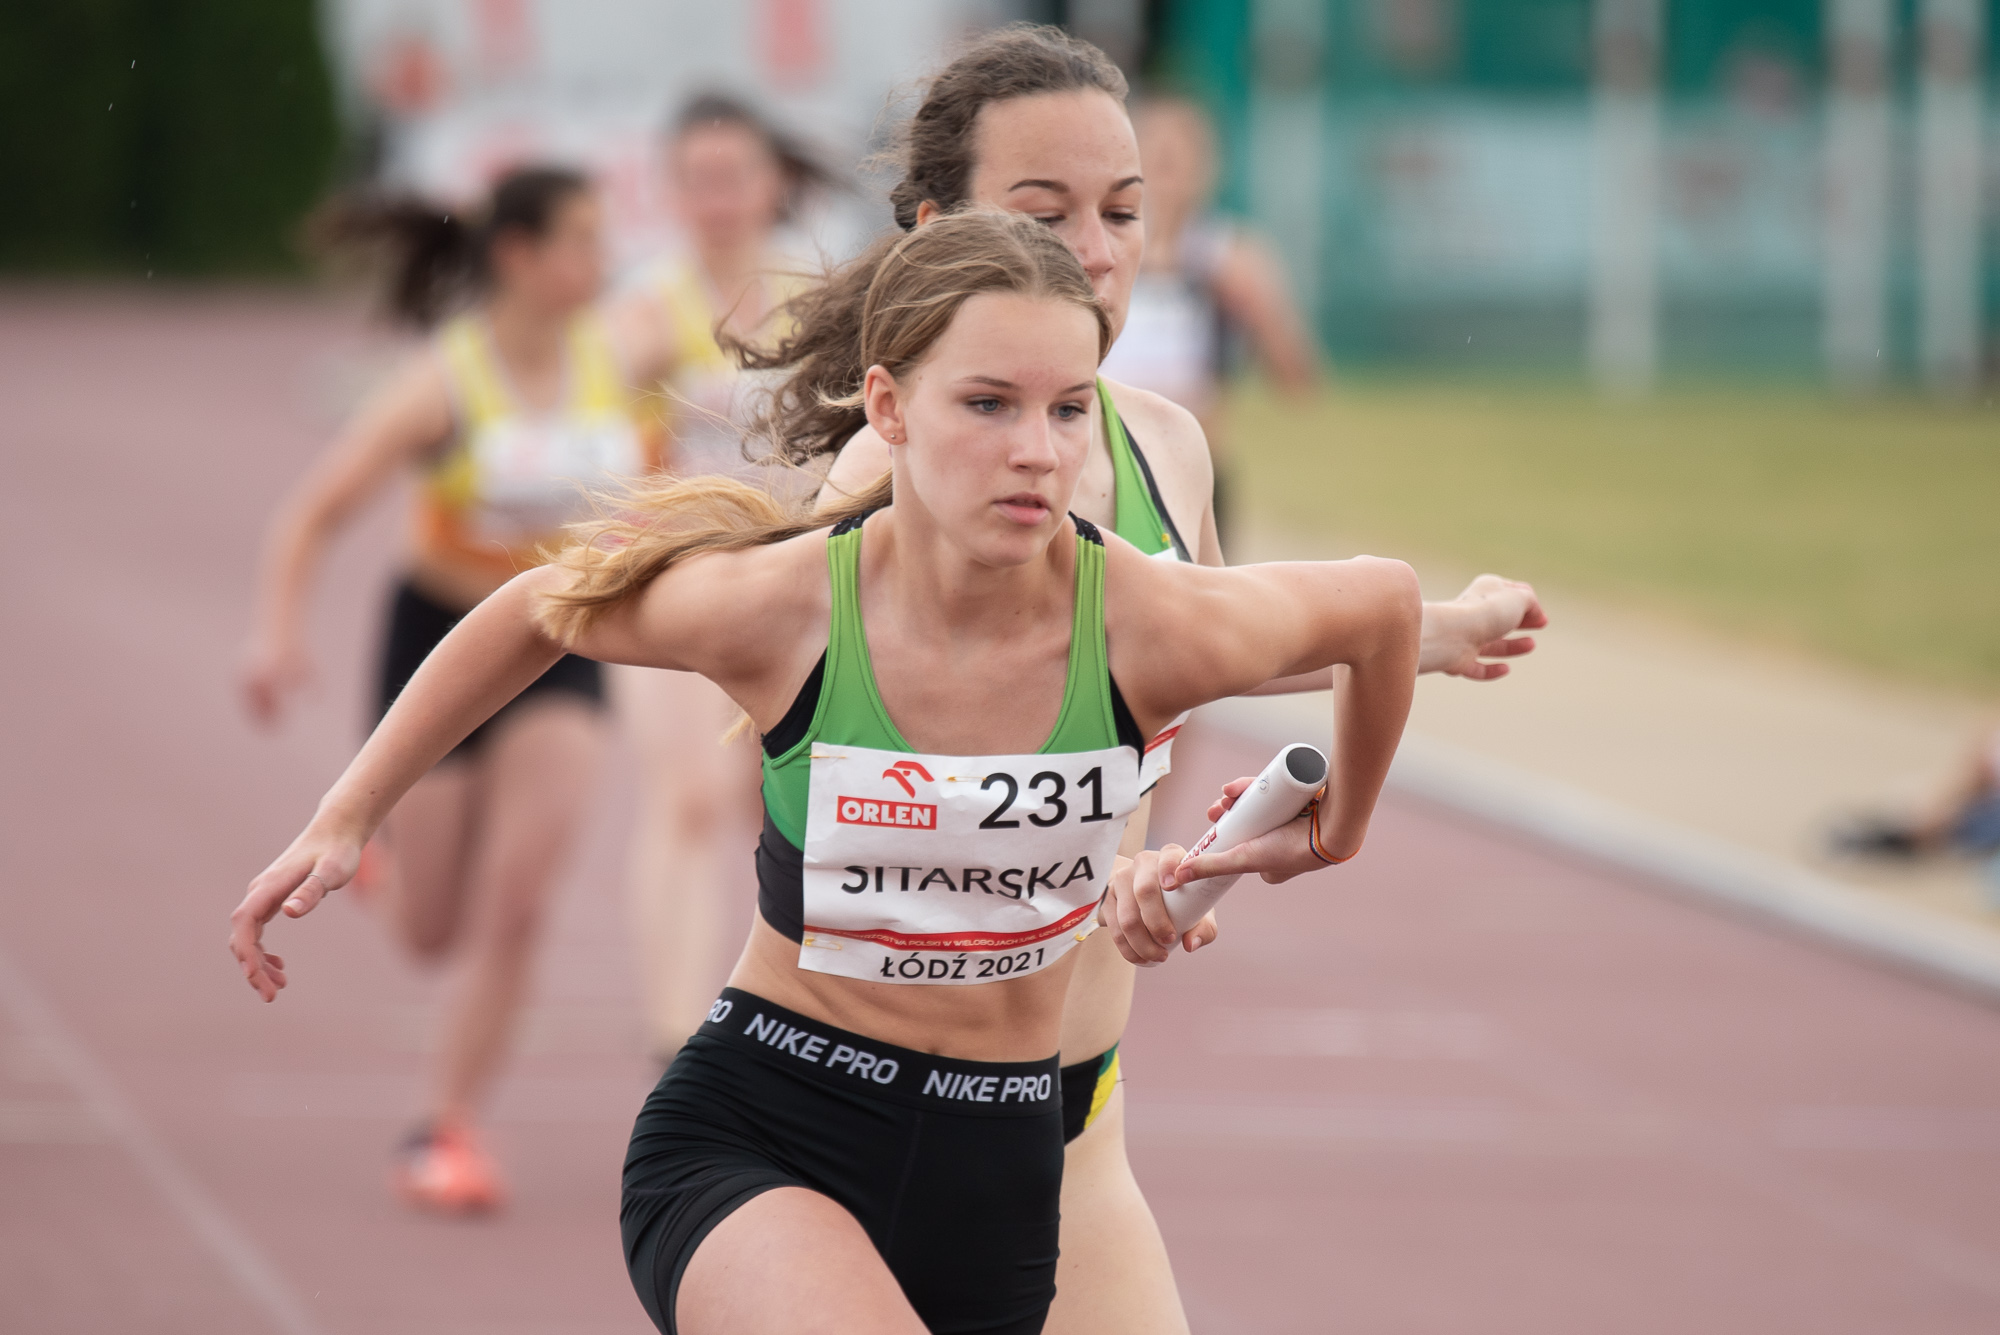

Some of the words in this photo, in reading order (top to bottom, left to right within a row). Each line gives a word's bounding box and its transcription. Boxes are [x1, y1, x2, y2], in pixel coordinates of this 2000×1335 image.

[841, 801, 931, 827] ORLEN
[979, 766, 1113, 830] 231
[841, 856, 1095, 900] SITARSKA
[953, 938, 1018, 947] WIELOBOJACH
[880, 952, 967, 979] ŁÓDŹ
[976, 947, 1045, 978] 2021
[706, 998, 733, 1023] RO
[743, 1013, 830, 1064] NIKE
[825, 1043, 899, 1085] PRO
[922, 1070, 1000, 1103] NIKE
[999, 1073, 1052, 1103] PRO
